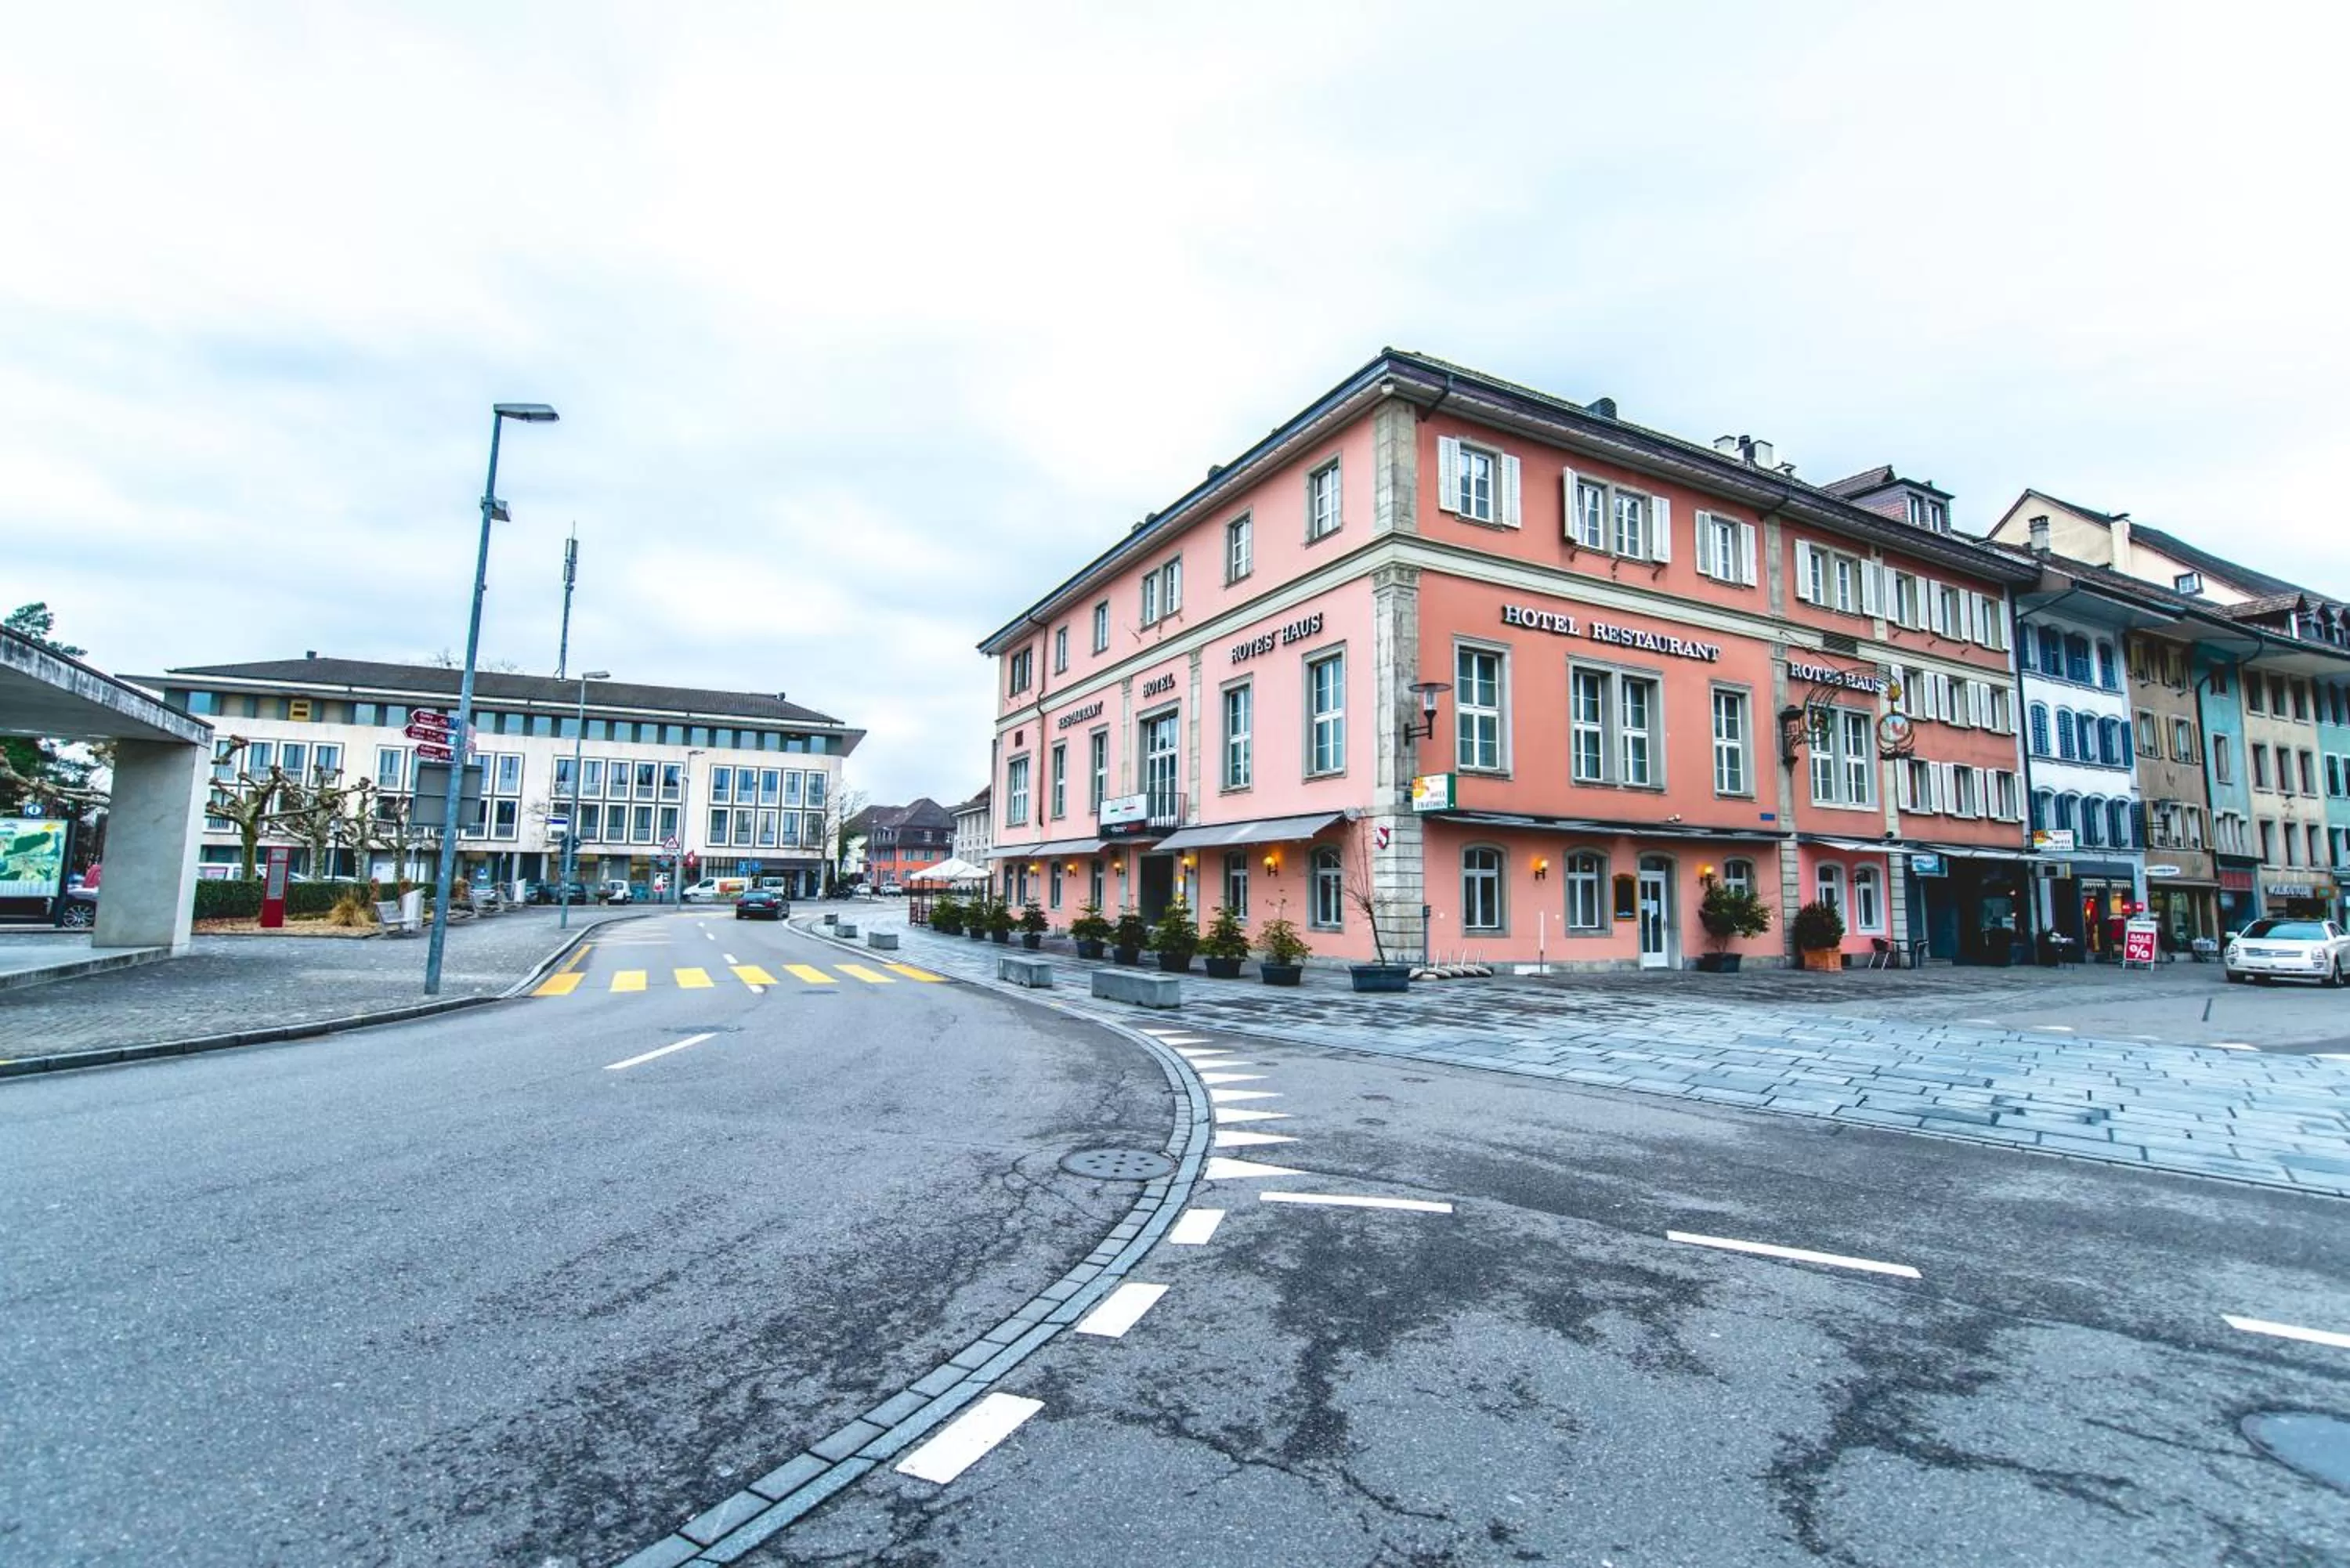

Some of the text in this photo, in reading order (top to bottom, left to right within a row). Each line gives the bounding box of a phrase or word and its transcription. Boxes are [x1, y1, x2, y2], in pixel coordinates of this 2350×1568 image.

[1231, 612, 1323, 664] ROTES HAUS
[1502, 604, 1720, 663] HOTEL RESTAURANT
